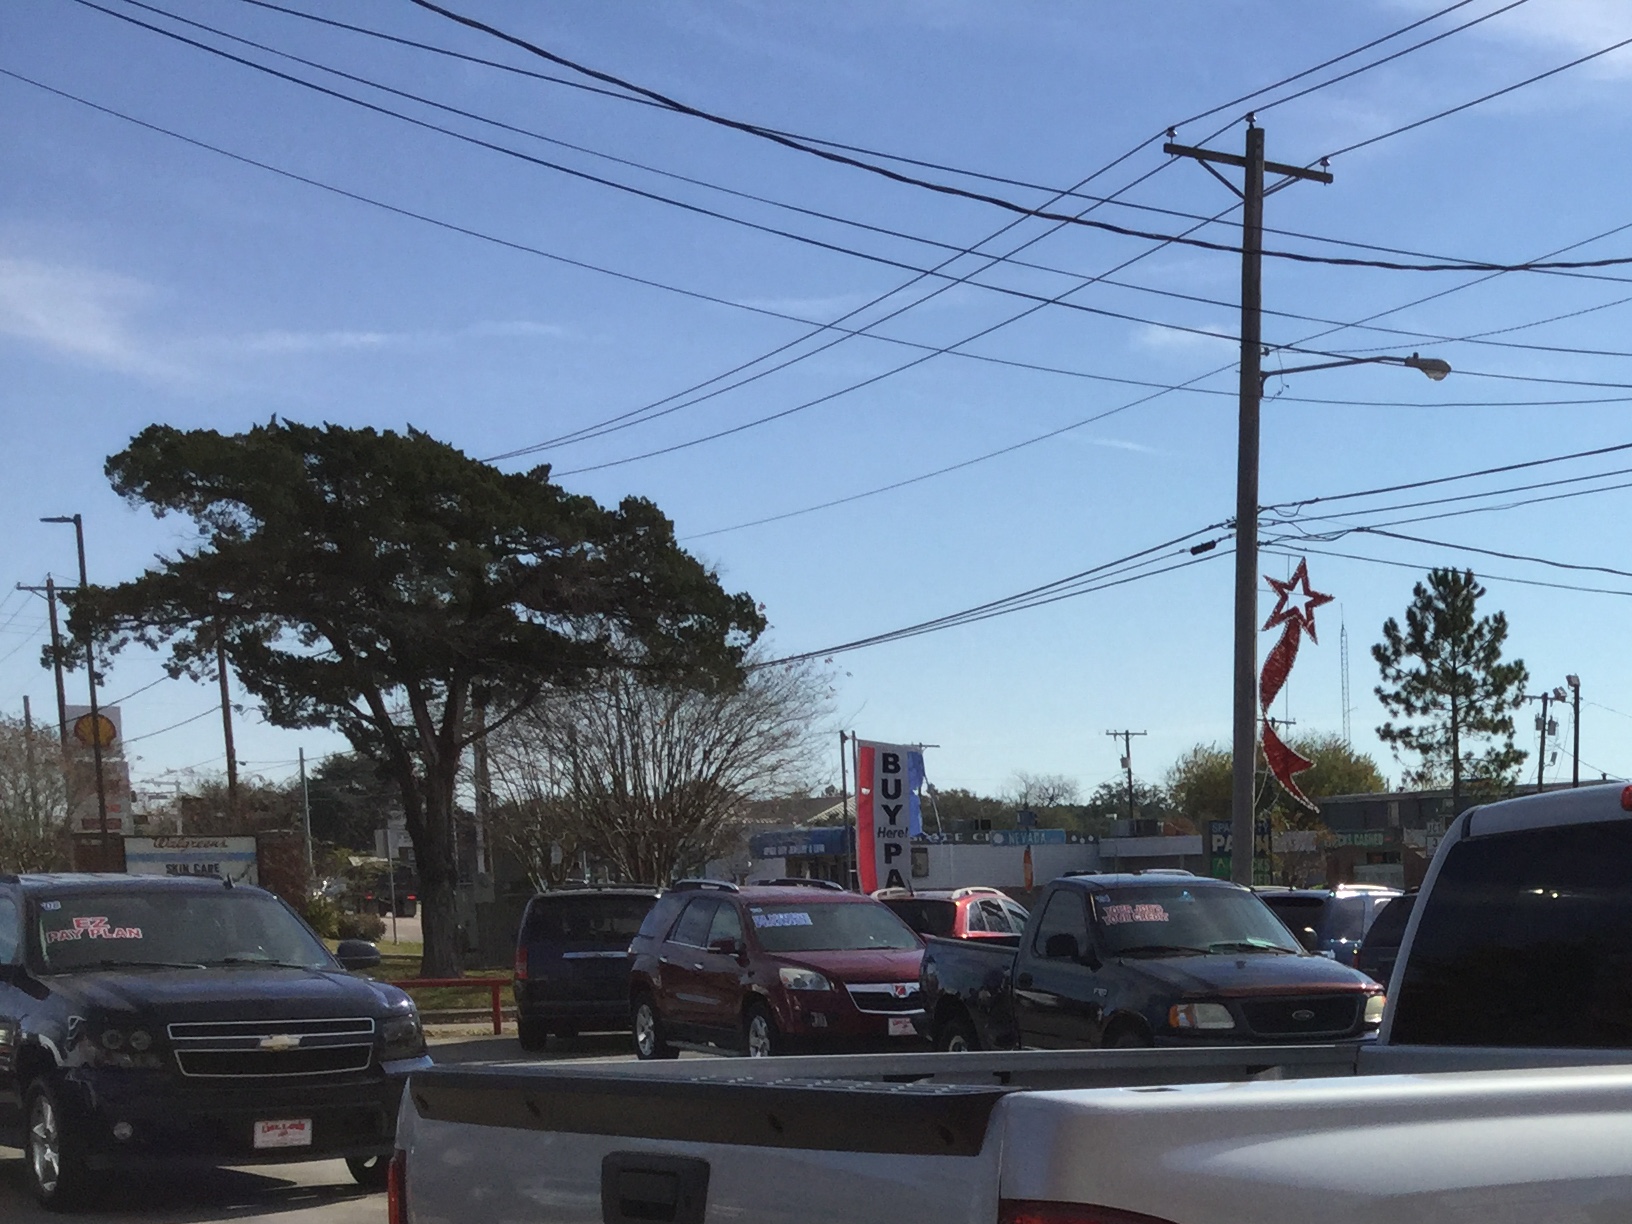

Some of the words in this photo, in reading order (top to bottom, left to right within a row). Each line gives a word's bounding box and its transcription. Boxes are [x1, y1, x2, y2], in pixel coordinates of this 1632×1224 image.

[881, 752, 903, 826] BUY
[877, 826, 909, 839] Here!
[1008, 832, 1046, 845] NEVADA
[153, 837, 228, 853] Walgreens
[1211, 834, 1270, 853] PAN
[1354, 833, 1384, 847] CASHED
[165, 863, 189, 874] SKIN
[193, 863, 220, 874] CARE
[883, 842, 907, 889] PA
[73, 917, 111, 930] EZ
[1102, 913, 1133, 926] YOUR
[46, 928, 83, 943] PAY
[88, 927, 143, 939] PLAN
